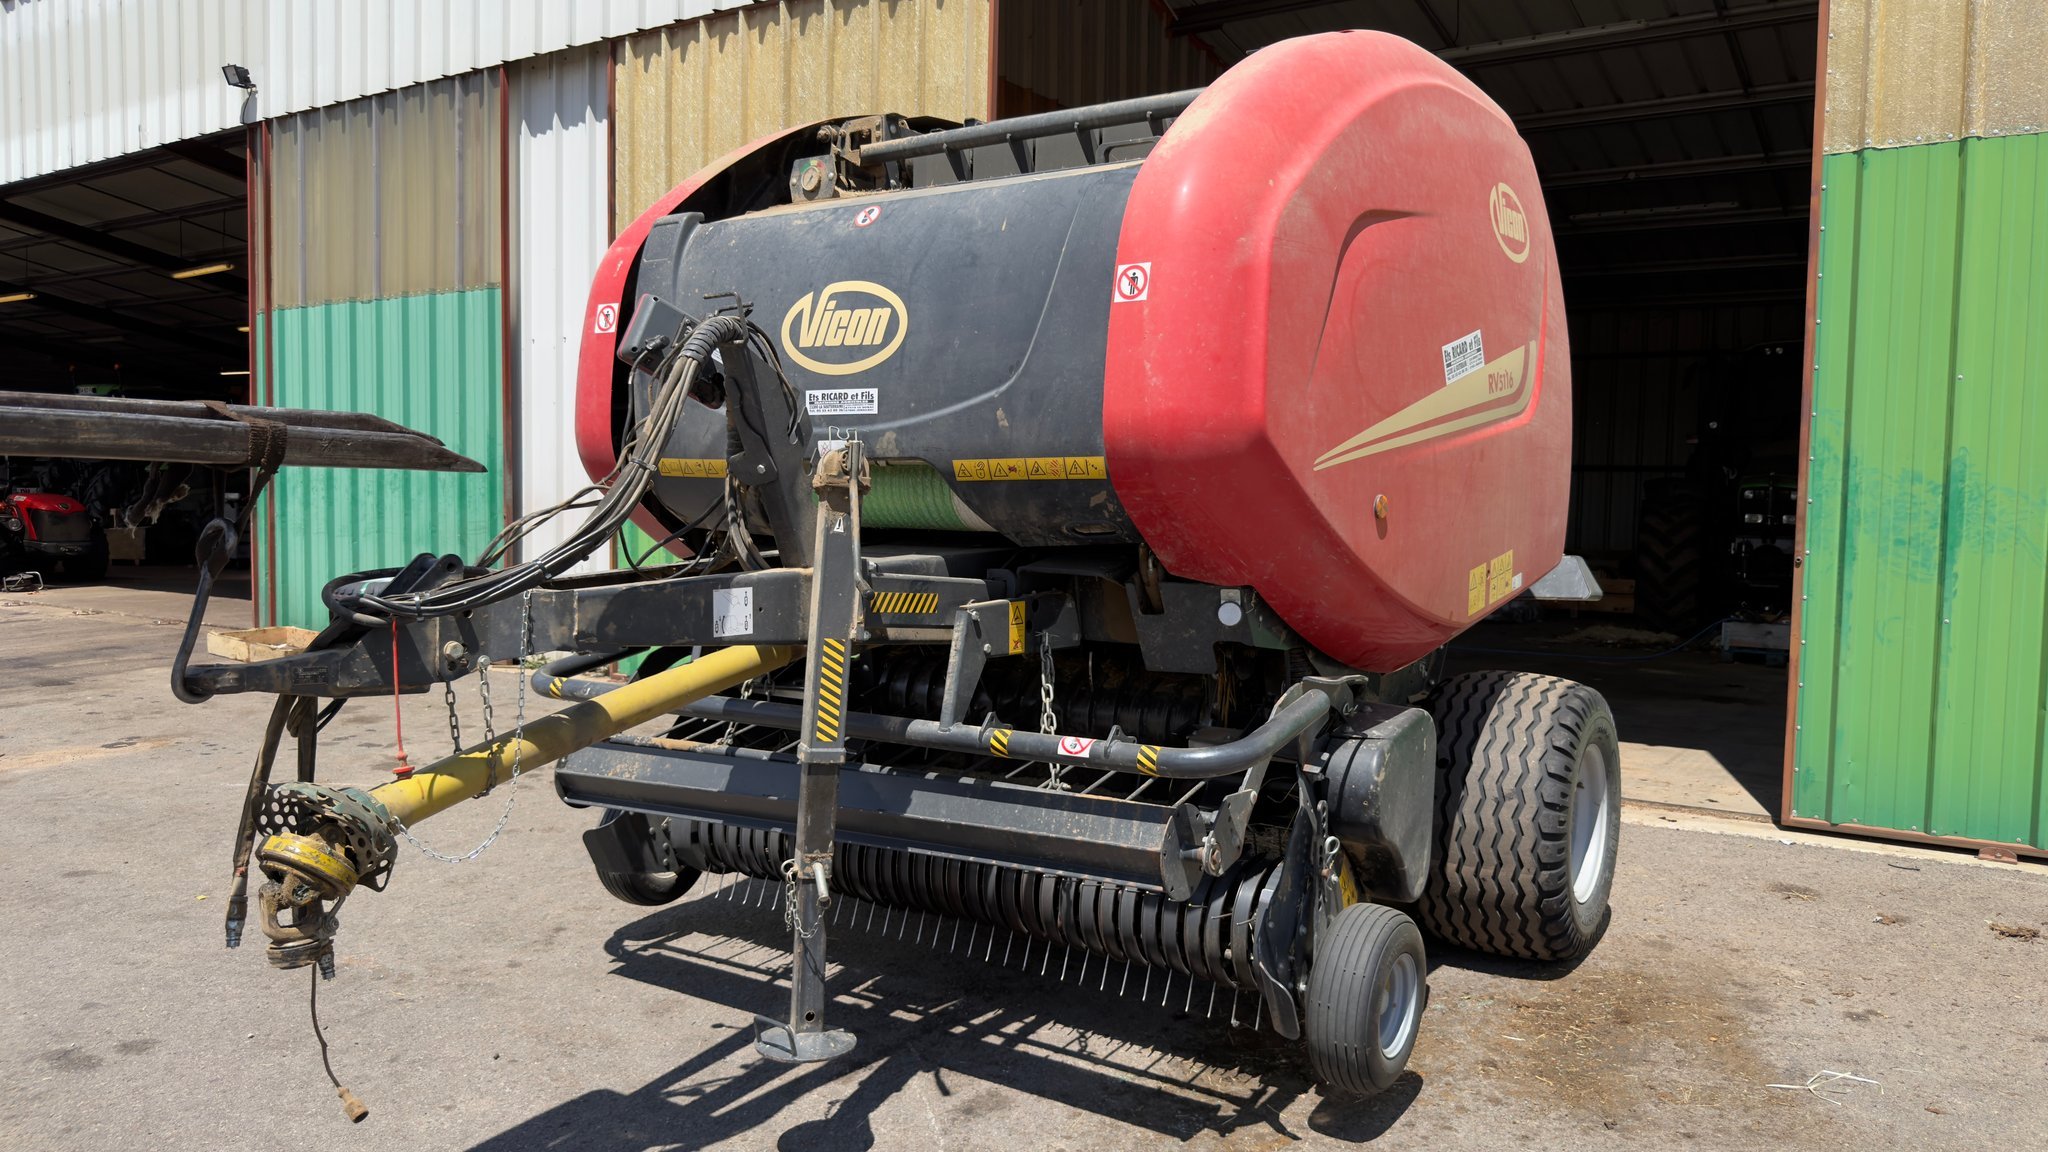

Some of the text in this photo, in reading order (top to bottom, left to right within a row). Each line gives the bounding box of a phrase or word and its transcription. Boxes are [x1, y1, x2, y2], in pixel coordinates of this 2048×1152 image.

[798, 289, 892, 348] Vicon
[1452, 341, 1468, 358] RICARD
[1488, 369, 1514, 395] RV5116
[808, 390, 874, 402] Ets RICARD et Fils
